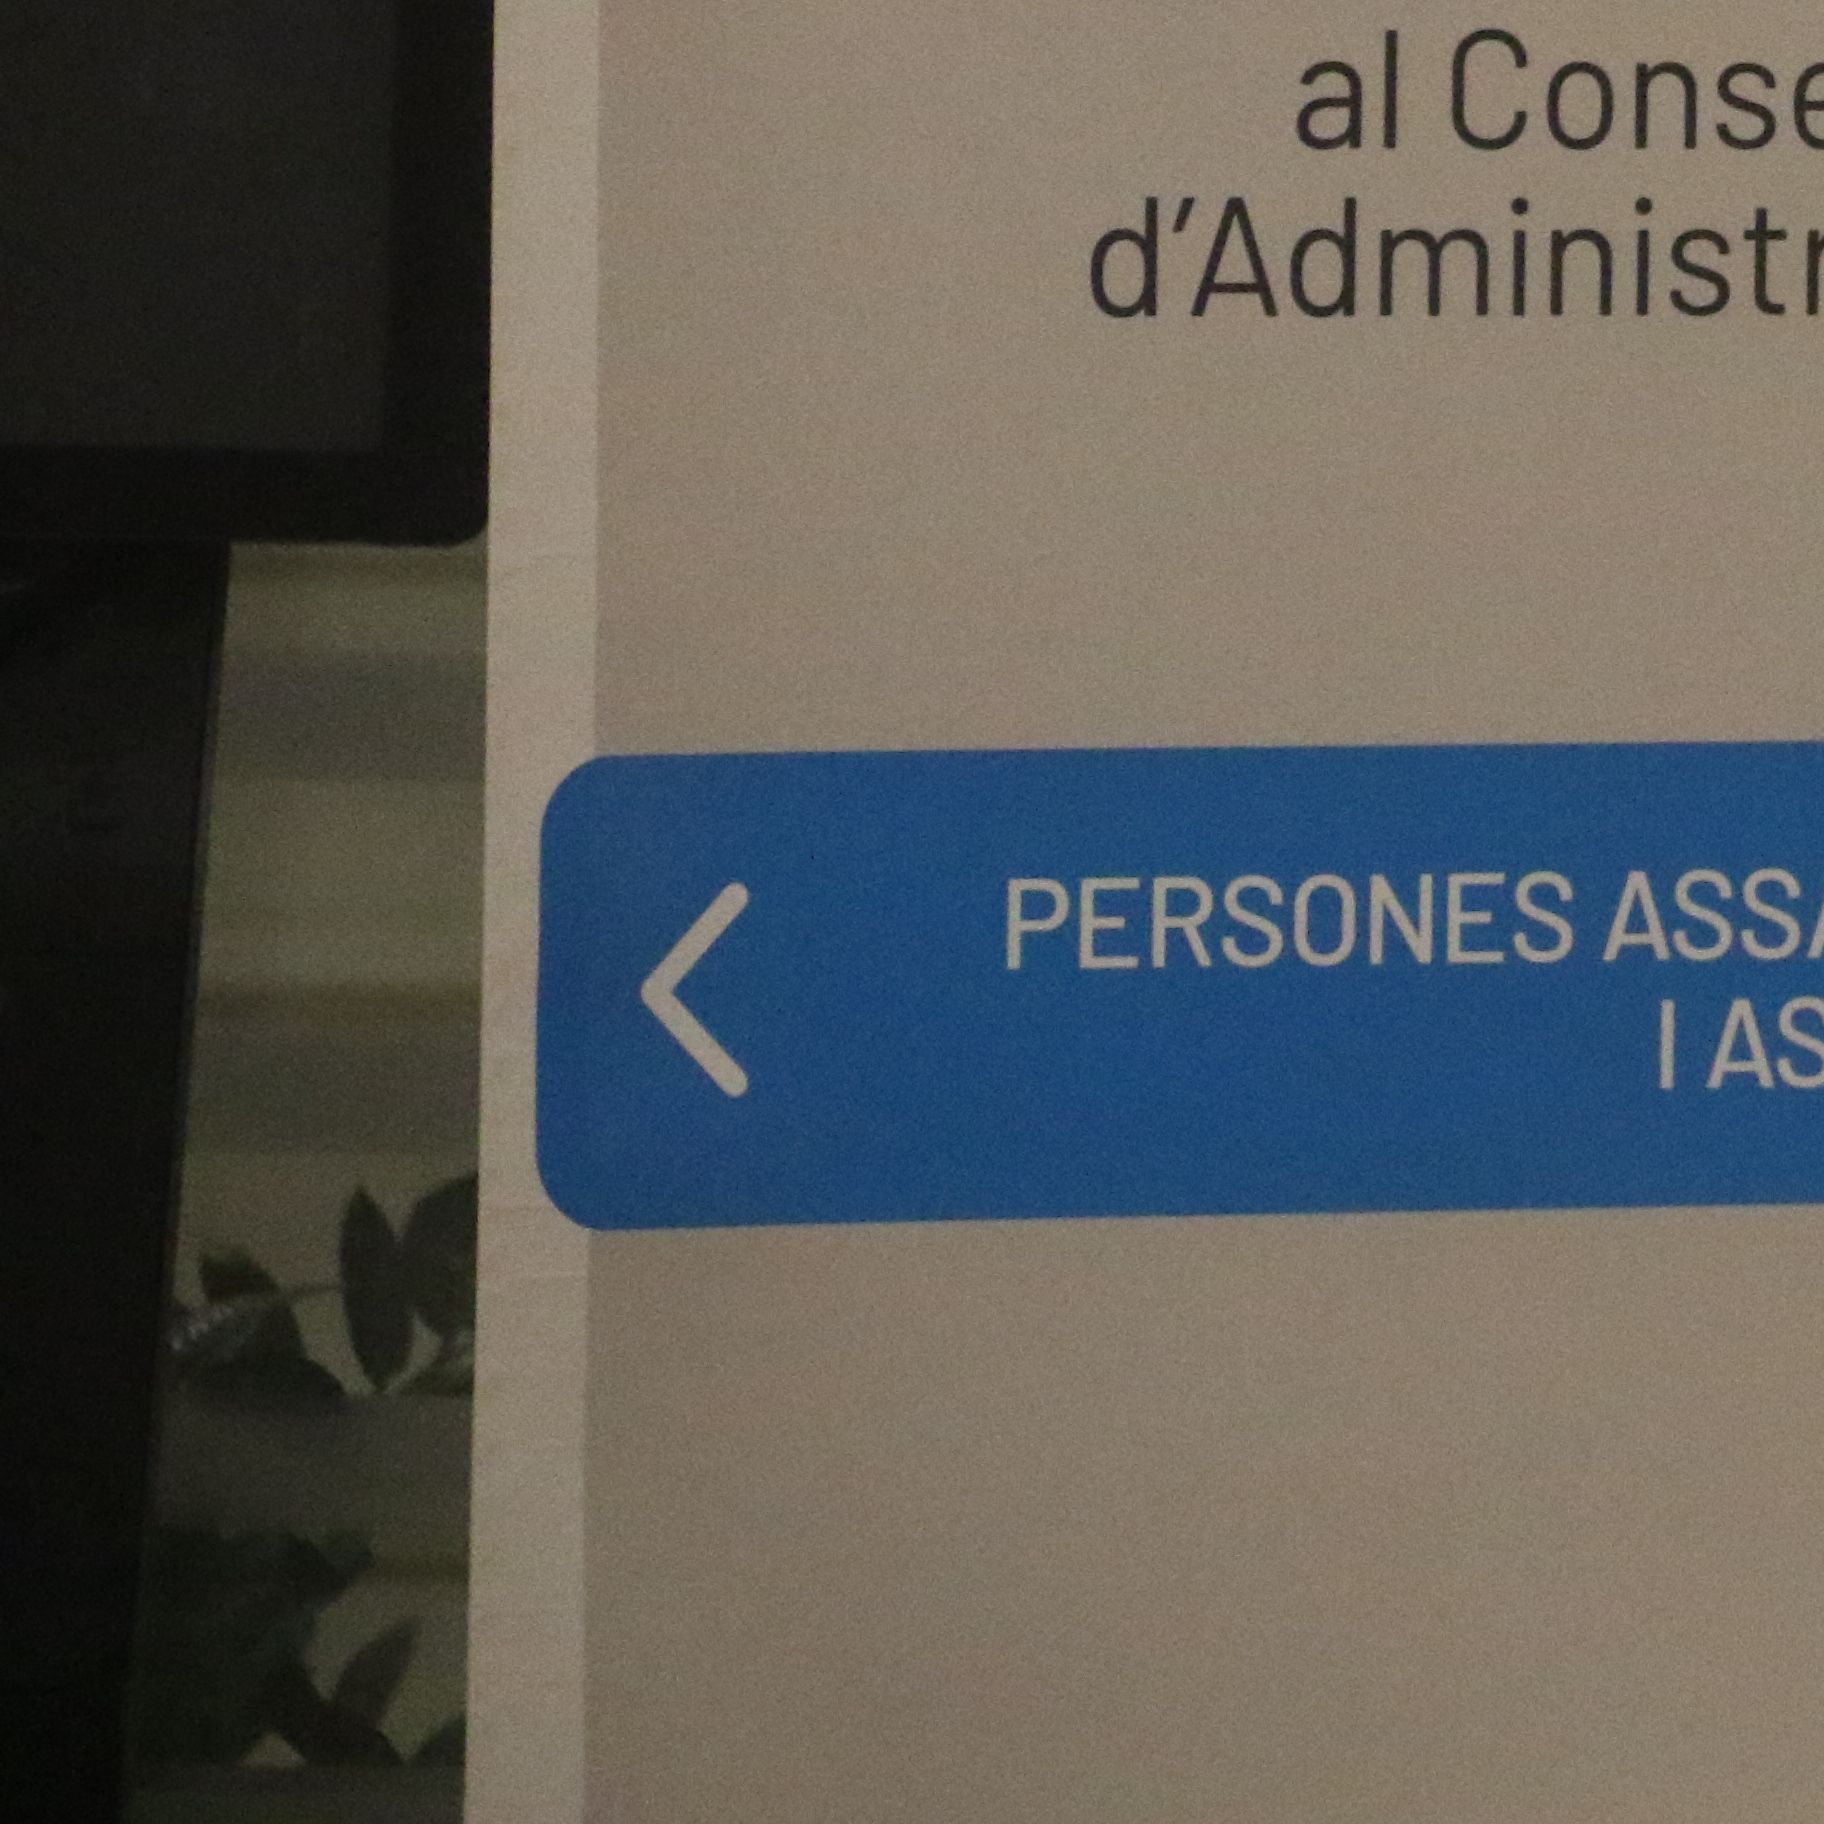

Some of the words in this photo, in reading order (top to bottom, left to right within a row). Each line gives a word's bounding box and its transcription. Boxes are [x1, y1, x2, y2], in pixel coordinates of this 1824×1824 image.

[1297, 30, 1398, 150] al
[1007, 871, 1573, 969] PERSONES
[1658, 999, 1677, 1090] I
